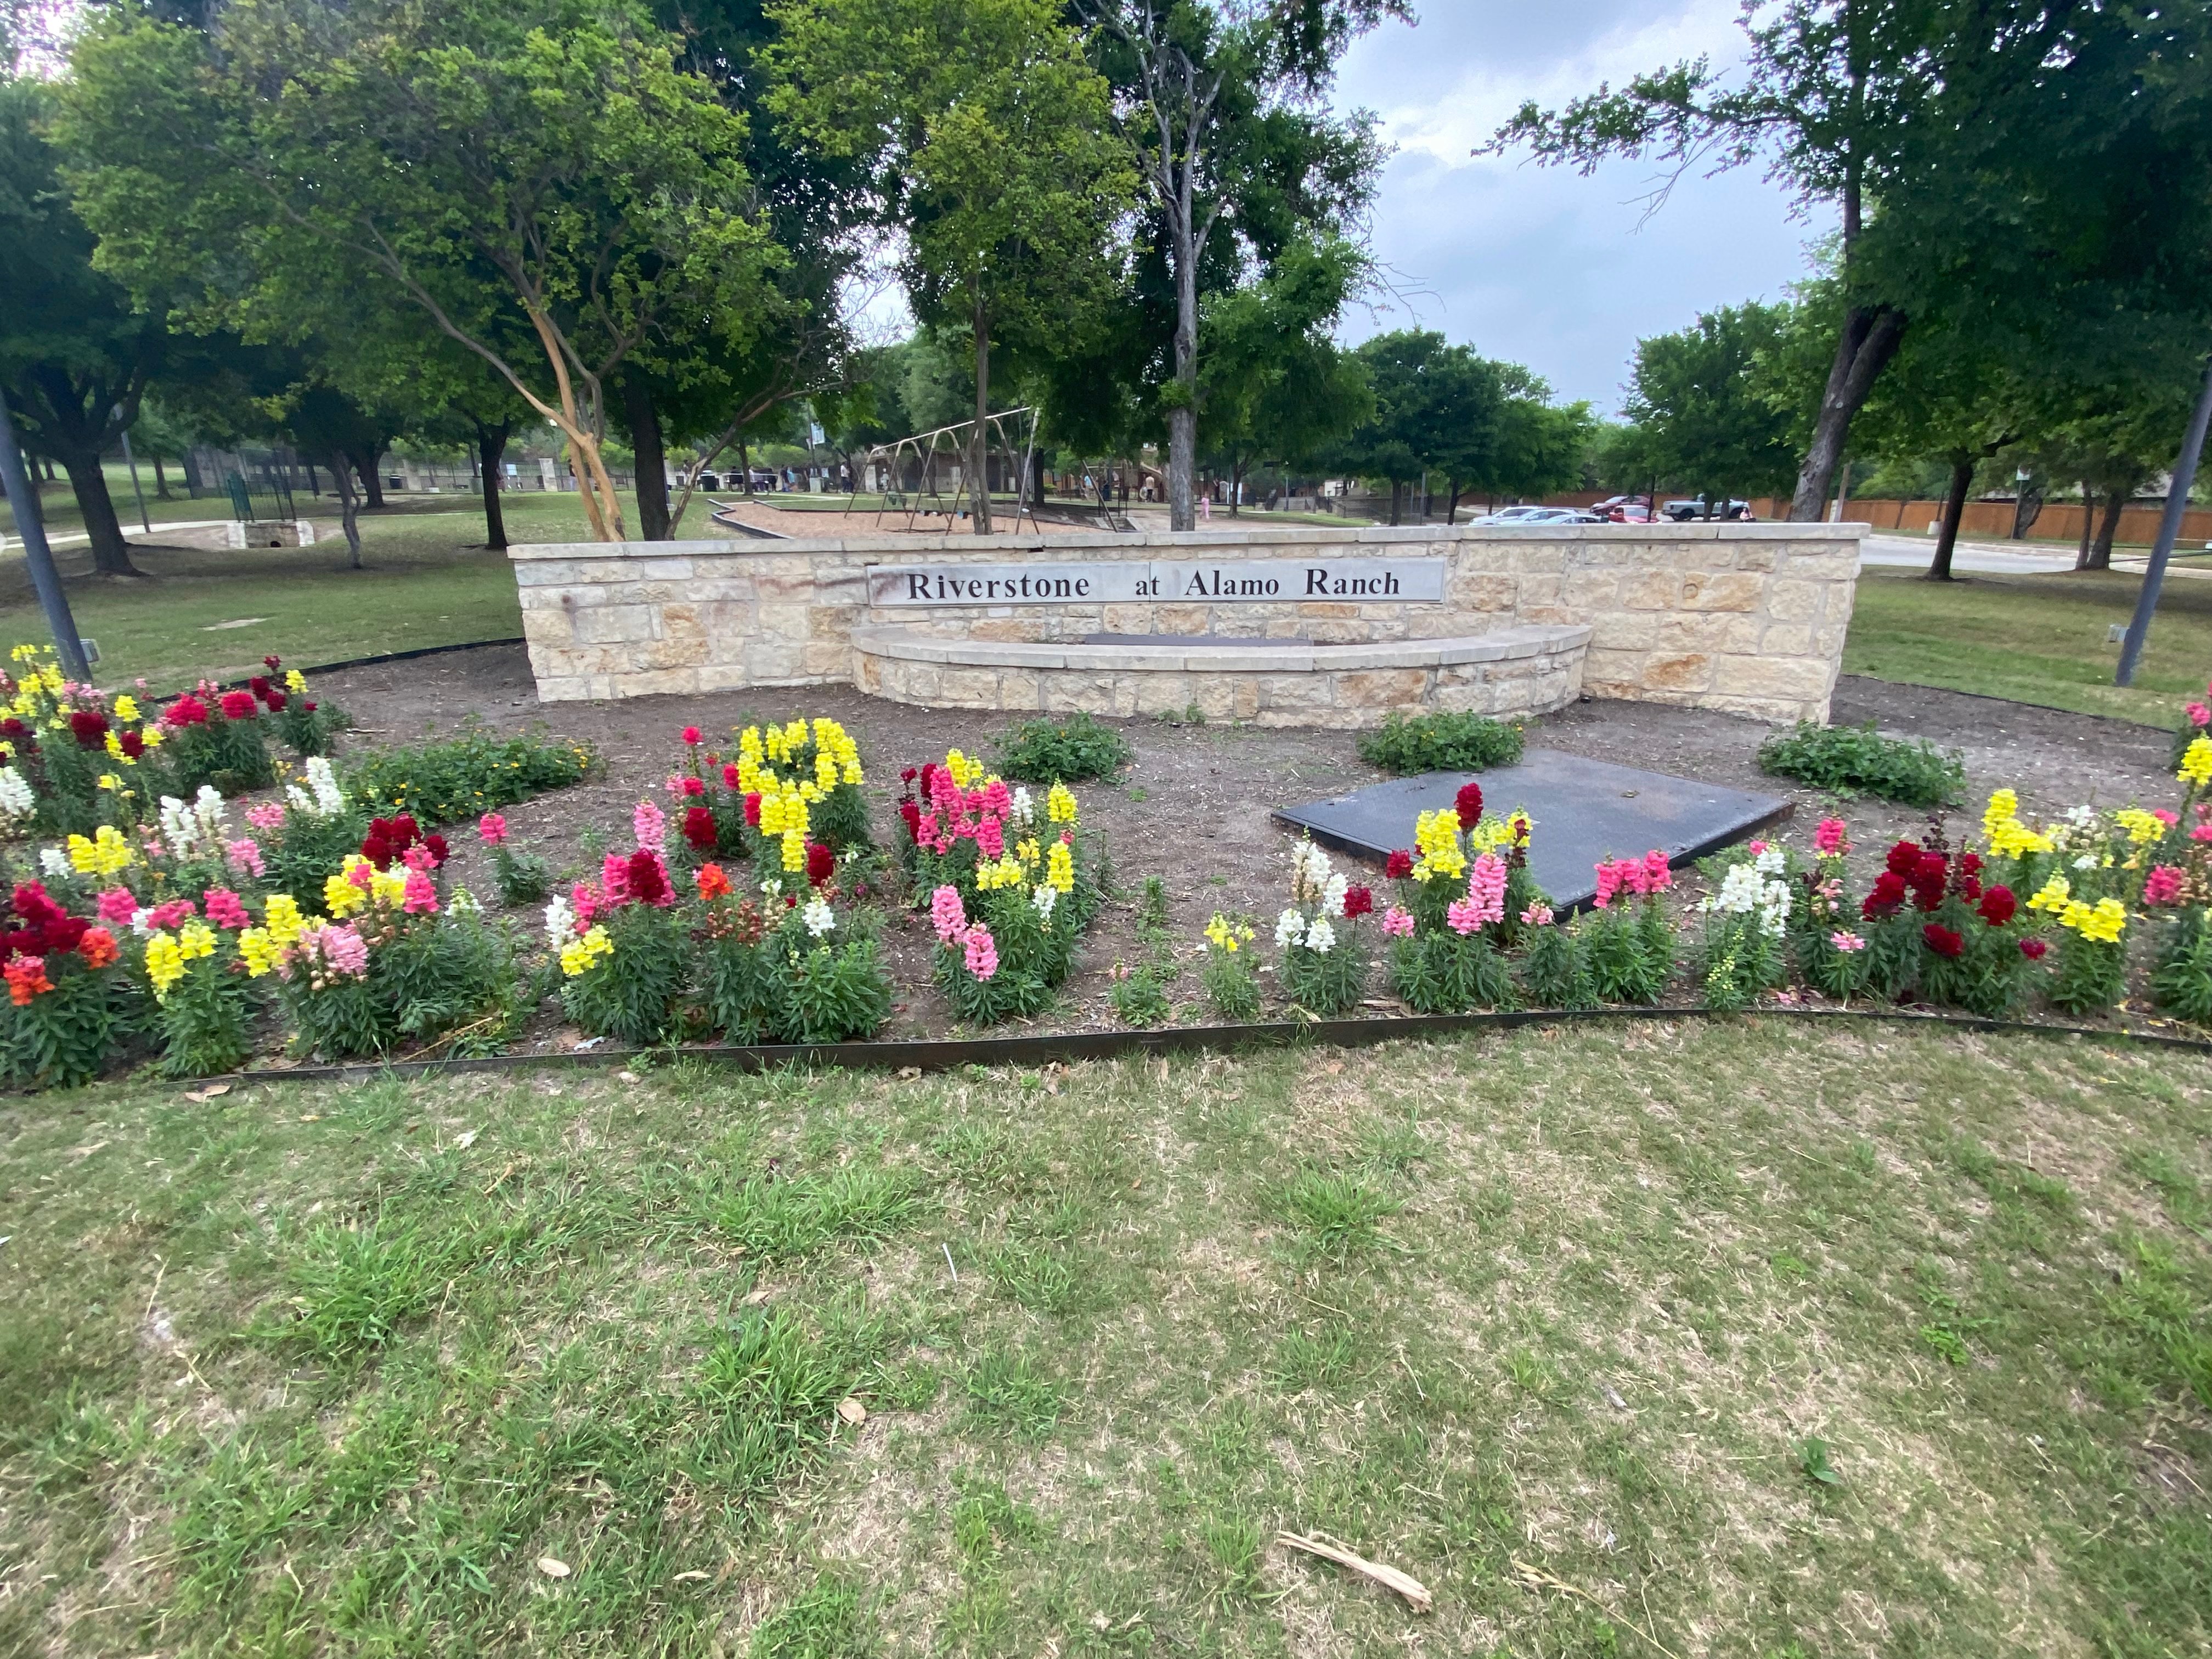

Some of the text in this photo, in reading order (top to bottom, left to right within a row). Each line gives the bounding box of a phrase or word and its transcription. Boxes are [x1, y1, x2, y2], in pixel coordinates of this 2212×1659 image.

[907, 568, 1400, 600] Riverstone at Alamo Ranch
